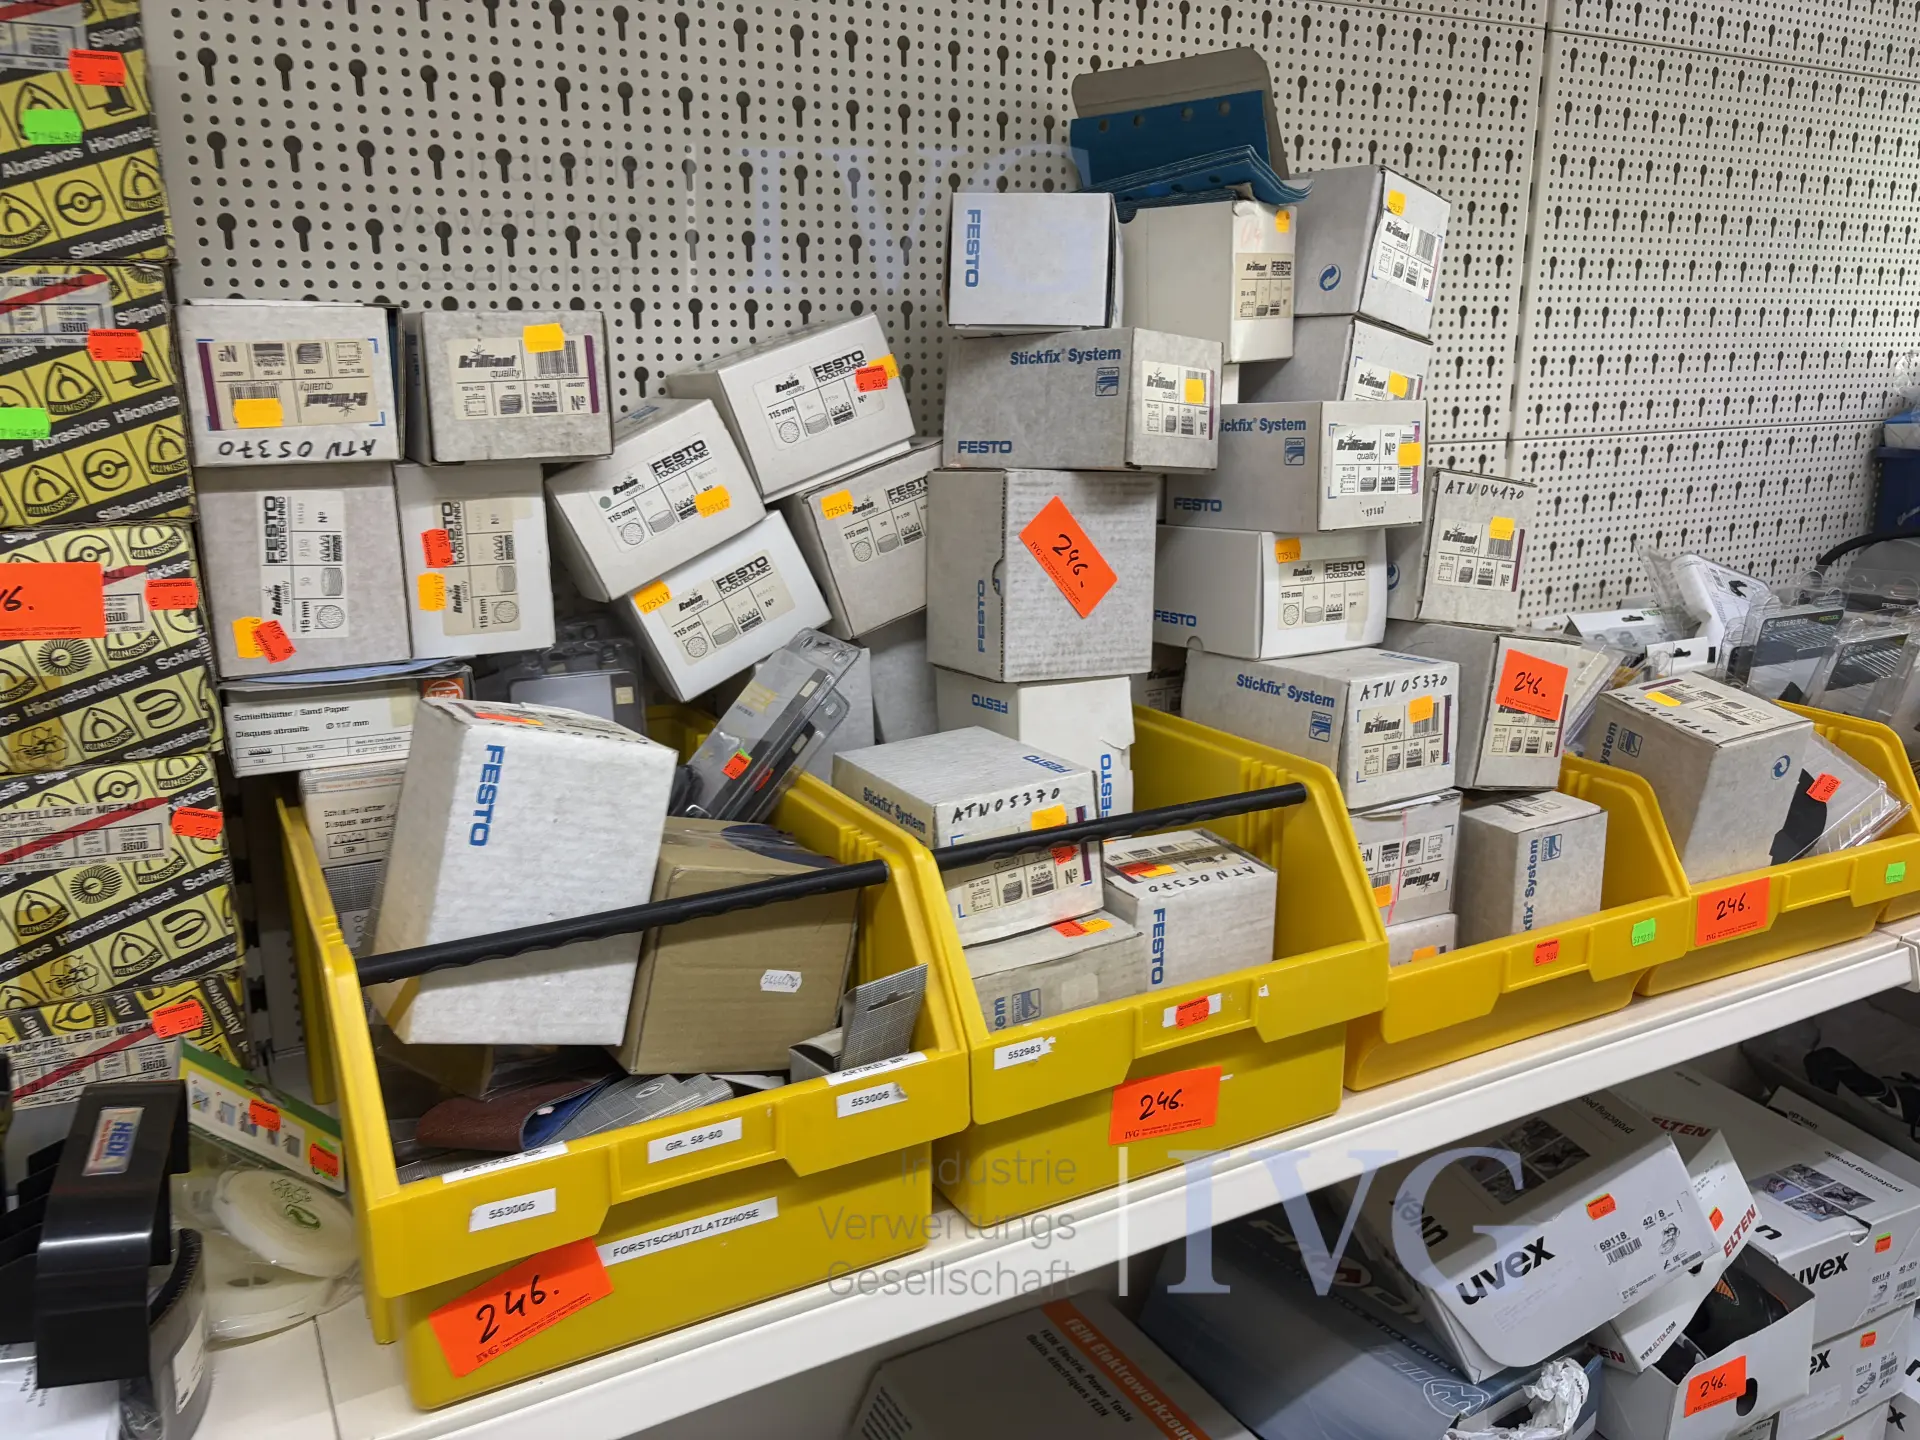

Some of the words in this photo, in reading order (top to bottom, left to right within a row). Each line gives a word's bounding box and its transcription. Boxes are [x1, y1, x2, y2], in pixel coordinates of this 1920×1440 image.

[965, 209, 982, 288] FESTO
[1272, 261, 1291, 270] FESTO
[458, 354, 517, 369] Brilliant
[813, 349, 865, 378] FESTO
[1068, 347, 1122, 364] System
[816, 359, 867, 382] TOOLTECHNIC
[768, 409, 781, 420] 115
[781, 405, 796, 416] mm
[1259, 417, 1307, 434] System
[651, 440, 707, 473] FESTO
[957, 440, 1012, 454] FESTO
[1336, 439, 1377, 452] Brilliant
[1356, 452, 1378, 462] quality
[655, 450, 710, 479] TOOLTECHNIC
[1173, 497, 1222, 512] FESTO
[264, 496, 279, 564] FESTO
[843, 530, 855, 540] 115
[856, 527, 869, 537] mm
[1443, 530, 1478, 545] Brilliant
[1030, 541, 1041, 556] IVG
[1459, 545, 1478, 555] quality
[715, 555, 768, 589] FESTO
[1325, 561, 1365, 573] FESTO
[1325, 571, 1366, 579] TOOLTECHNIC
[720, 565, 771, 595] TOOLTECHNIC
[977, 579, 986, 653] FESTO
[1154, 609, 1197, 627] FESTO
[673, 628, 687, 638] 115
[687, 621, 701, 632] mm
[1360, 679, 1396, 701] ATN
[1401, 673, 1448, 692] 05370
[1514, 671, 1546, 698] 246.
[971, 693, 1009, 714] FESTO
[1287, 685, 1335, 708] System
[235, 729, 272, 738] Disques
[1364, 718, 1401, 734] Brilliant
[1383, 730, 1403, 741] quality
[1599, 721, 1618, 766] ystem
[1023, 755, 1072, 774] FESTO
[469, 744, 506, 847] FESTO
[1100, 753, 1112, 819] FESTO
[895, 804, 926, 835] System
[1525, 839, 1538, 898] System
[1716, 892, 1752, 921] 246.
[0, 942, 53, 974] rasivos
[1150, 908, 1166, 985] FESTO
[1007, 1043, 1042, 1061] 552983
[850, 1090, 891, 1108] 553006
[1137, 1088, 1185, 1122] 246.
[1123, 1128, 1141, 1140] IVG
[1651, 1116, 1711, 1138] ELTEN
[1856, 1166, 1904, 1194] protecting
[487, 1200, 536, 1219] 553005
[1642, 1214, 1654, 1228] 42
[1659, 1209, 1666, 1219] 8
[613, 1207, 759, 1258] FORSTSCHUTZLATZHOSE
[1599, 1231, 1628, 1251] 69118
[1723, 1204, 1757, 1258] ELTEN
[1455, 1235, 1556, 1307] uvex
[475, 1273, 561, 1345] 246.
[1065, 1318, 1097, 1344] FEIN
[1640, 1321, 1677, 1362] WWW.ELTEN.COM
[1026, 1334, 1049, 1358] Outils
[1089, 1397, 1110, 1418] FEIN
[1040, 1329, 1060, 1346] FEIN
[1056, 1345, 1086, 1375] Electric
[1085, 1373, 1111, 1399] Power
[1111, 1399, 1133, 1422] Tools
[1699, 1372, 1727, 1398] 246.
